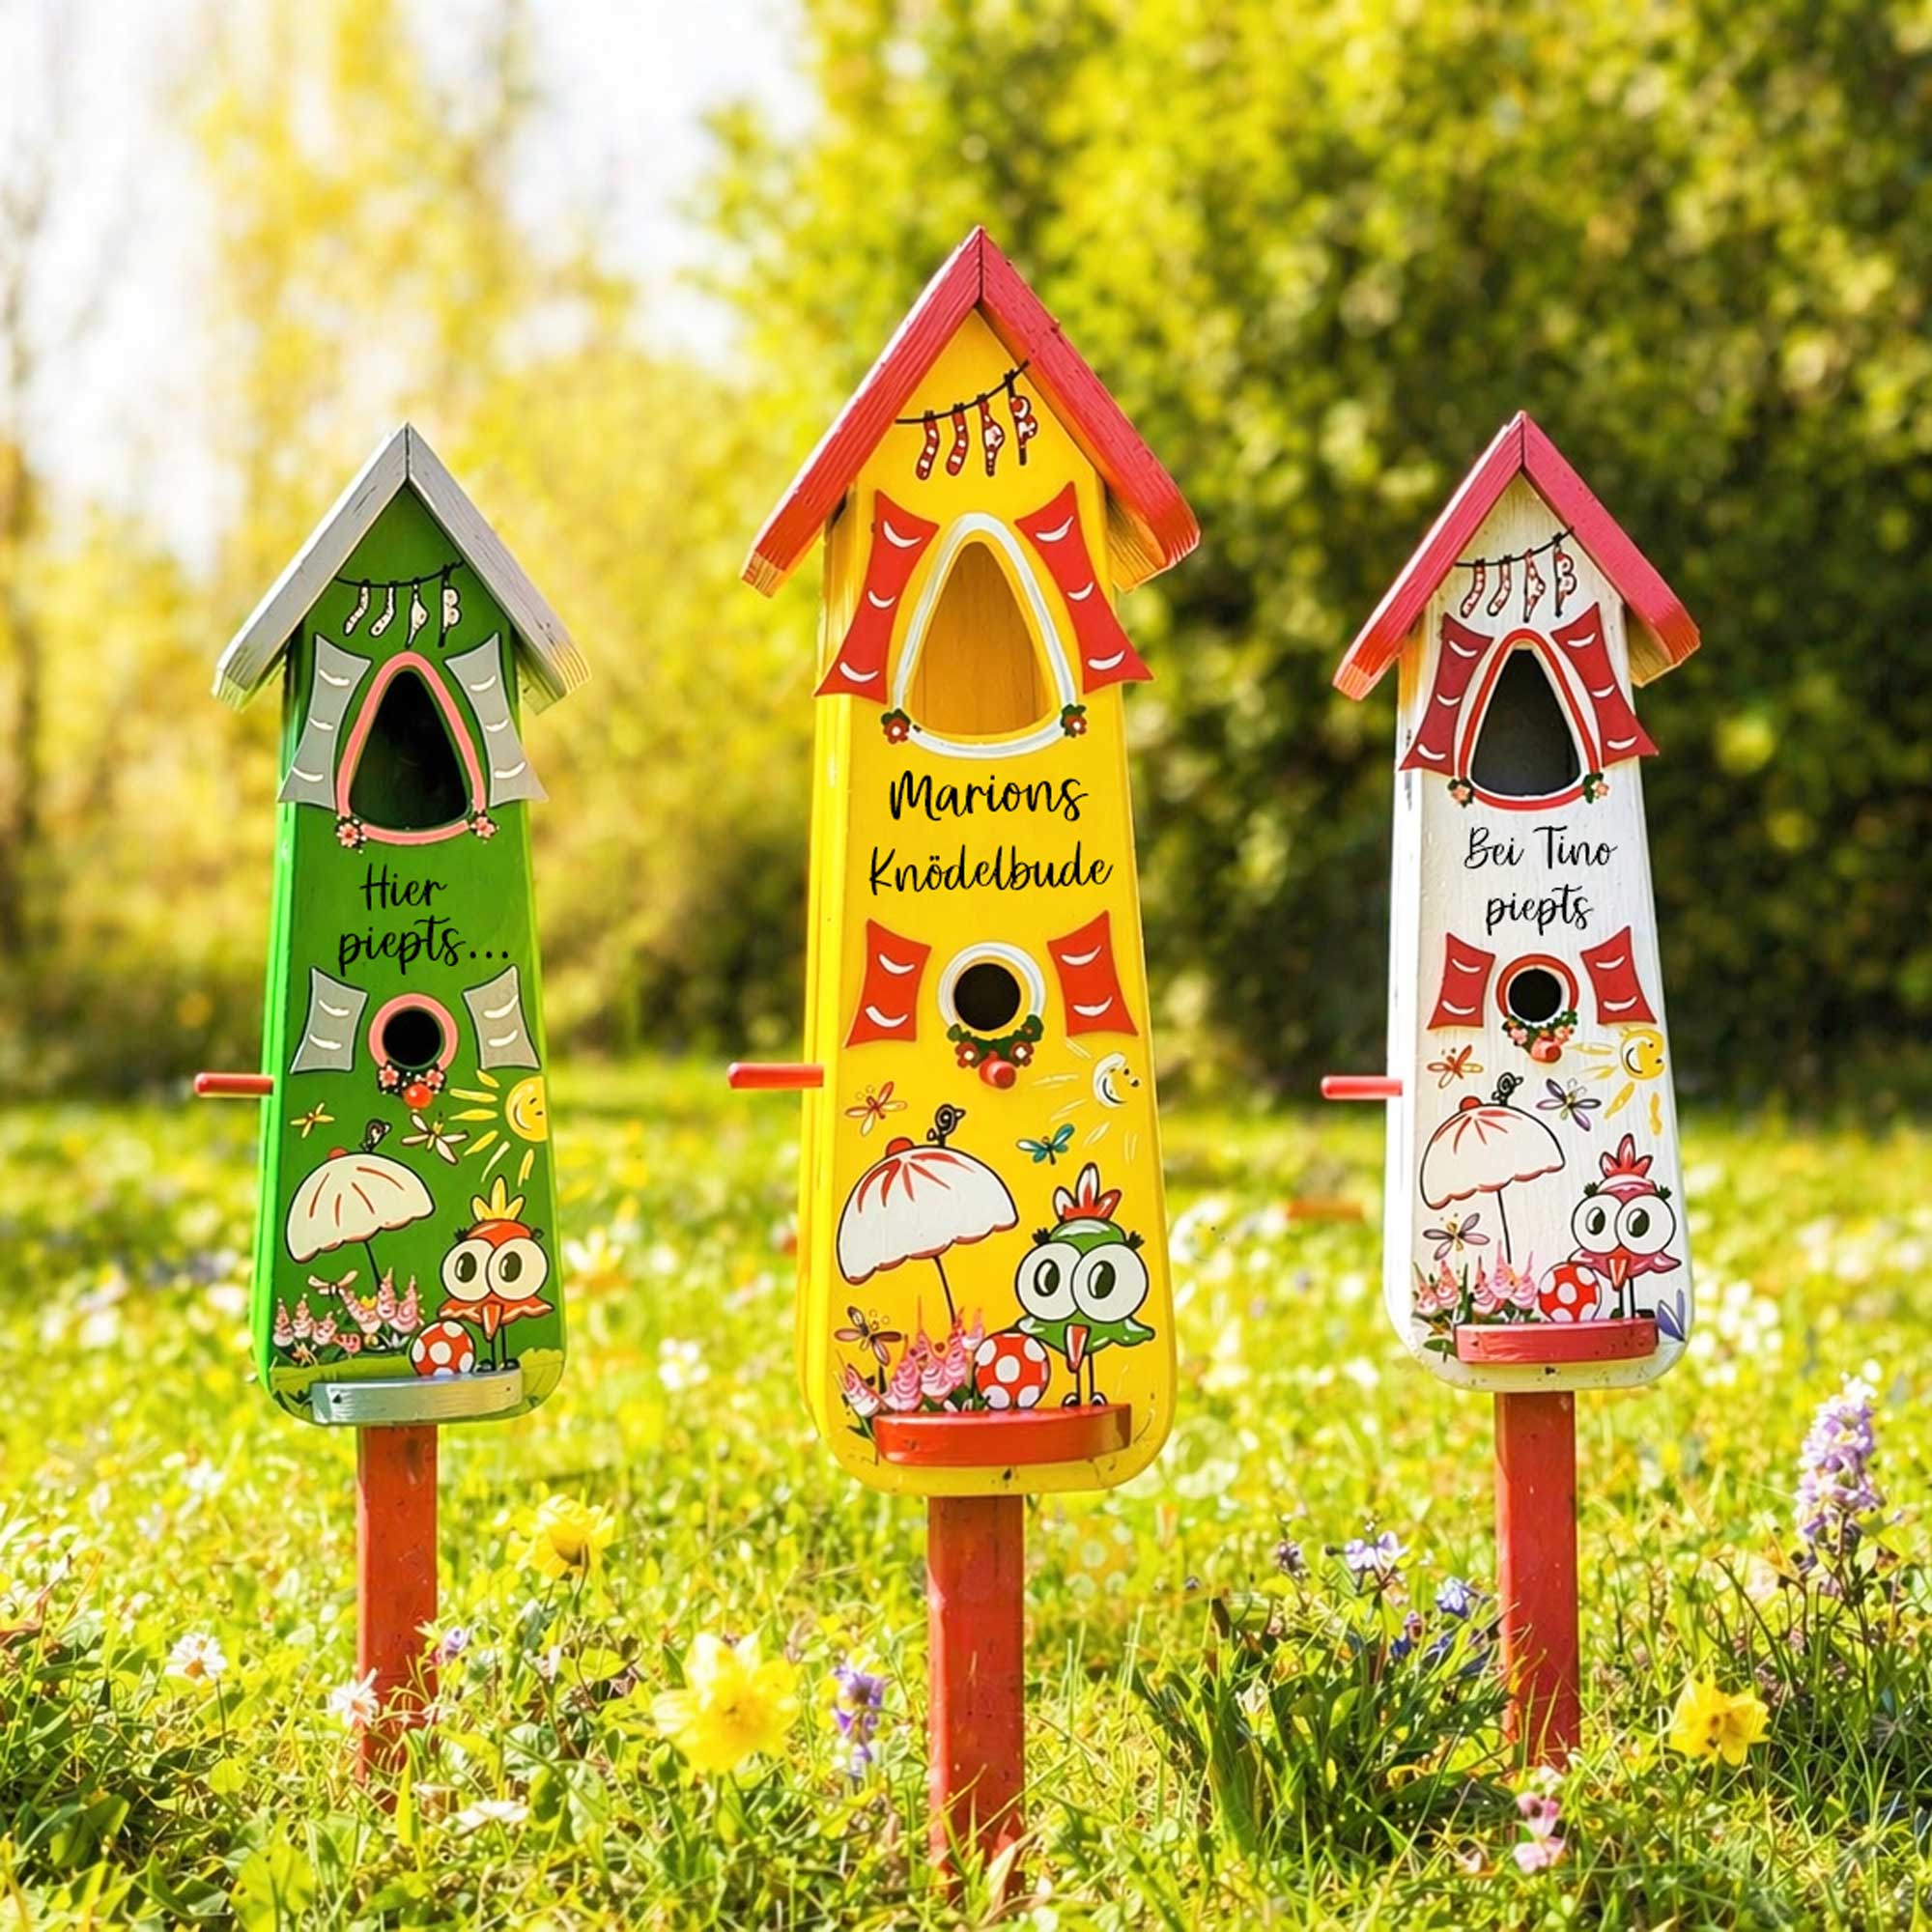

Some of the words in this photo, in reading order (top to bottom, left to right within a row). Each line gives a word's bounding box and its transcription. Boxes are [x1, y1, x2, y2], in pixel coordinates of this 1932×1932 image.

[889, 769, 1089, 821] Marions
[869, 840, 1114, 895] Knödelbude
[1463, 826, 1525, 870] Bei
[1532, 825, 1618, 870] Tino
[359, 862, 447, 911] Hier
[1485, 883, 1595, 936] piepts
[337, 915, 509, 976] piepts...
